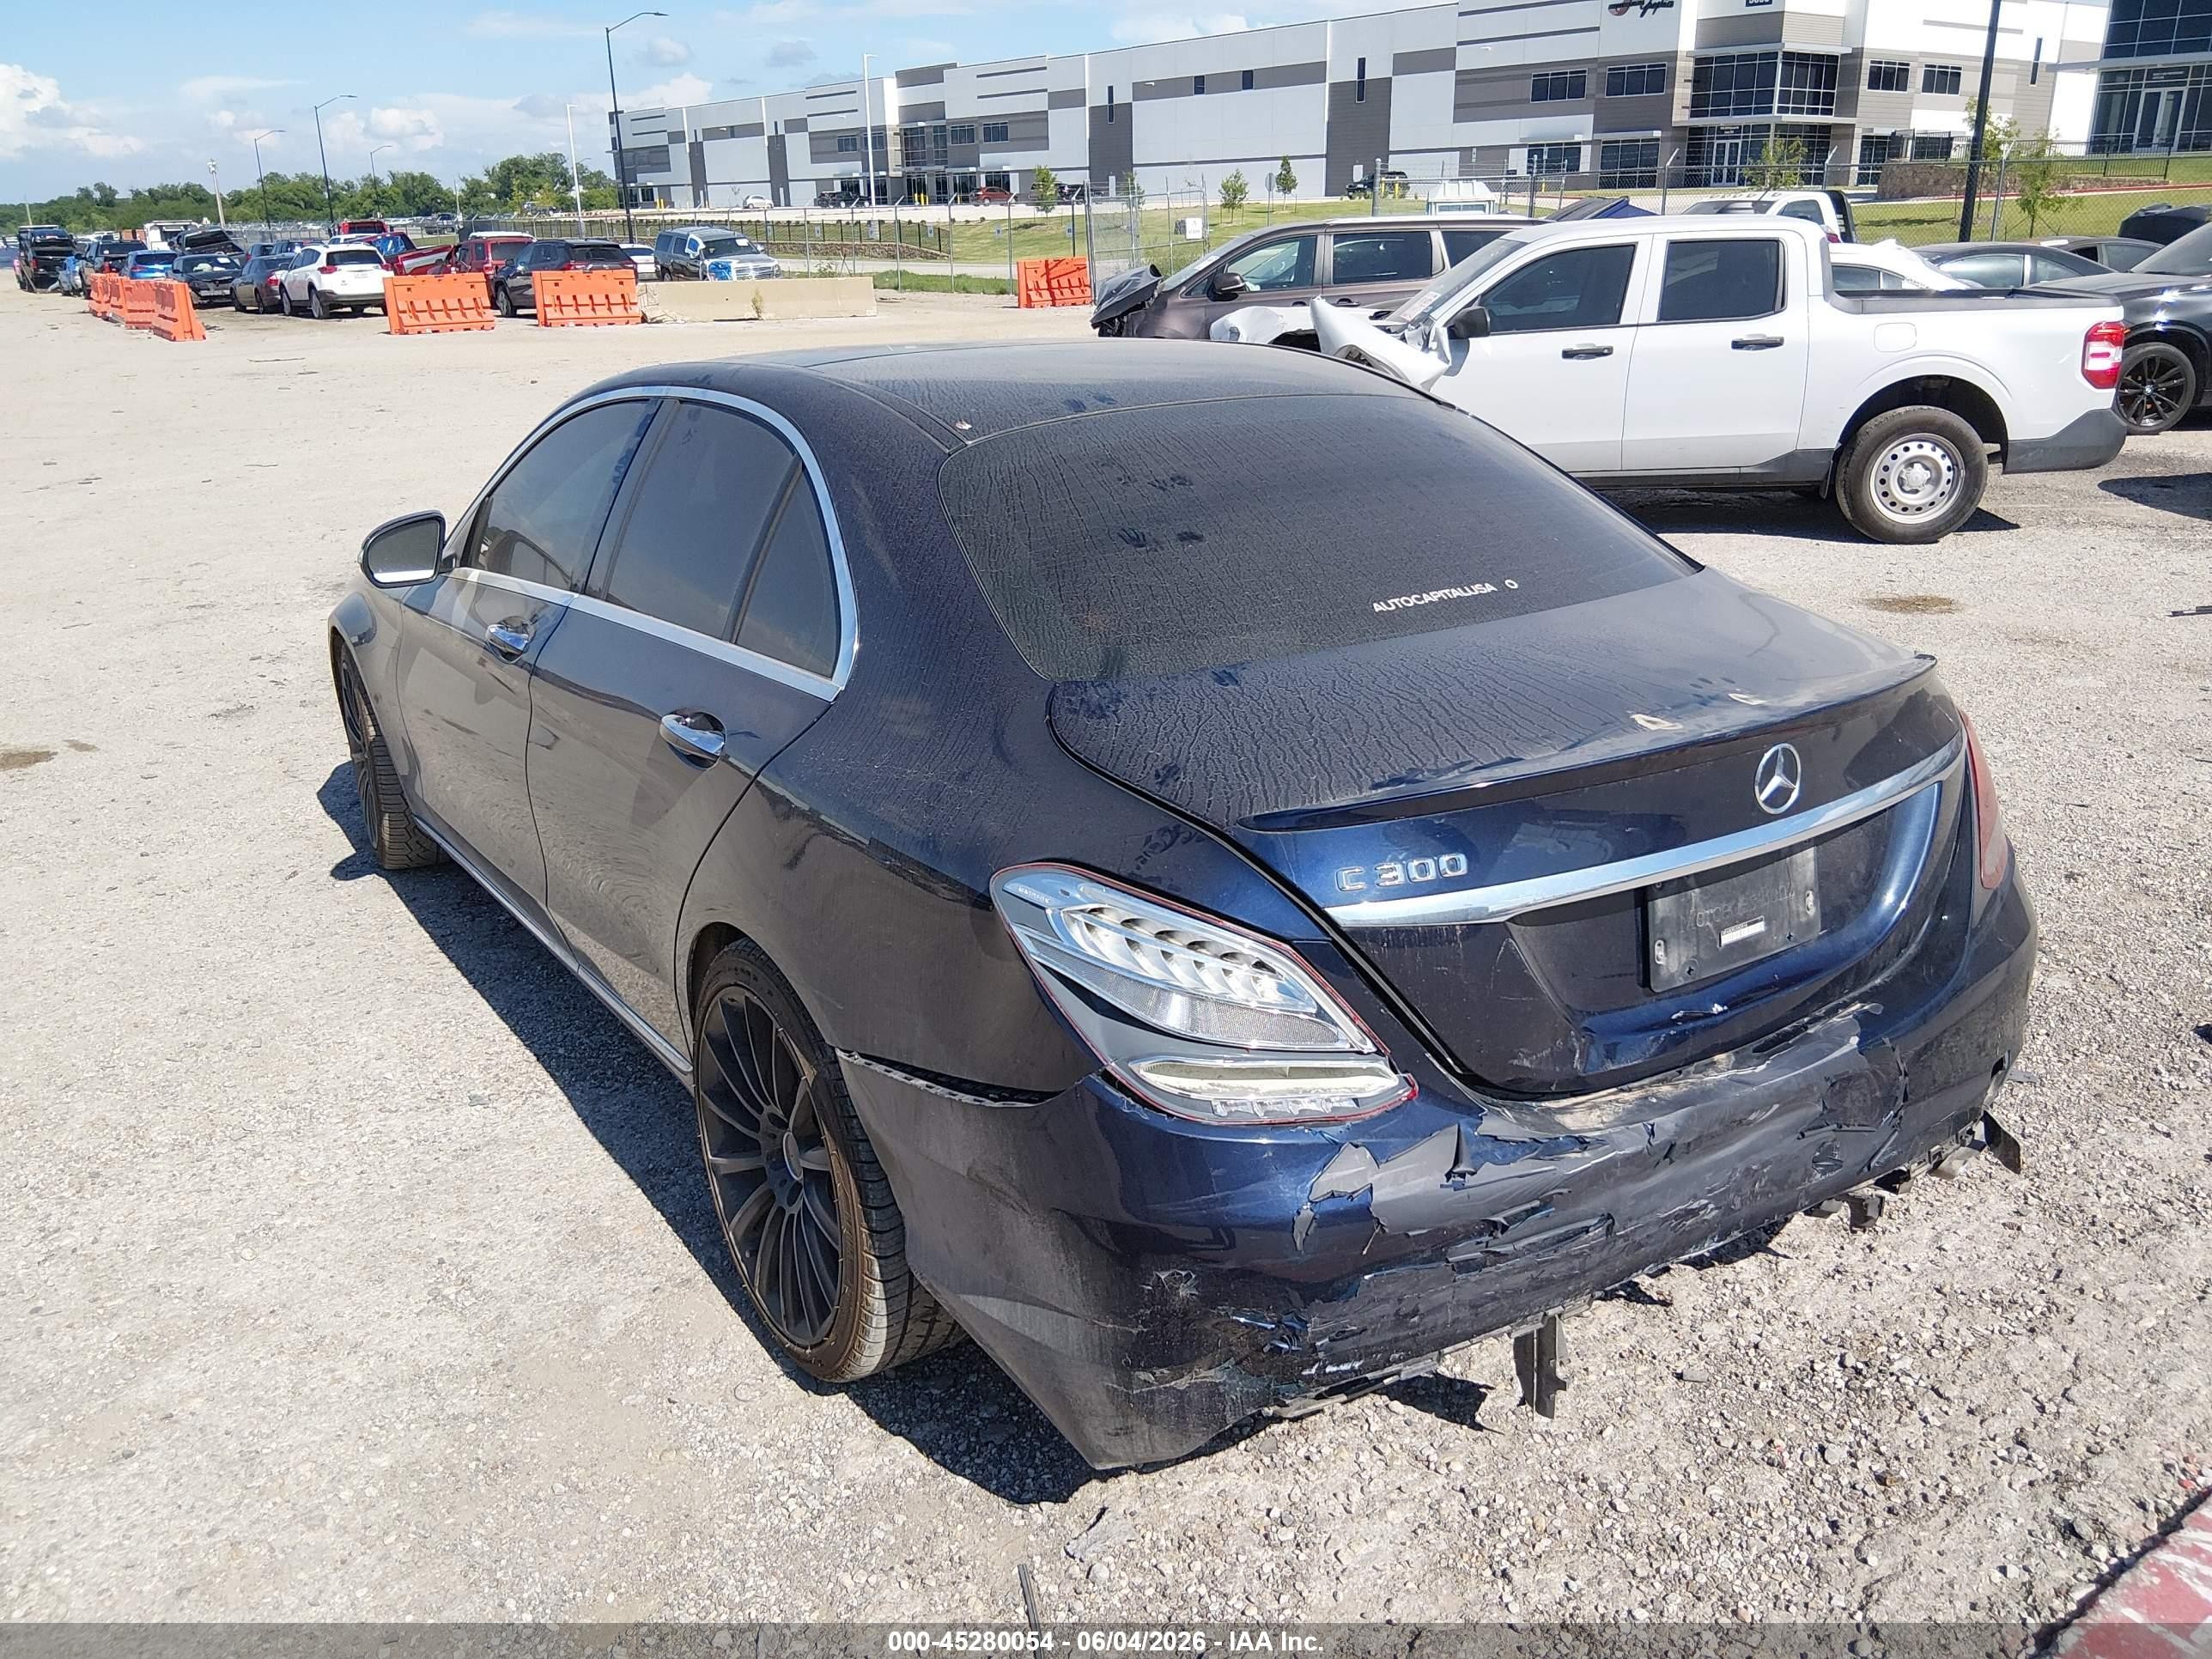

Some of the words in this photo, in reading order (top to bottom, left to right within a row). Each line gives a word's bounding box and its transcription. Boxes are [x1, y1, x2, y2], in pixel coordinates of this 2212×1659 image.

[1372, 581, 1498, 613] AUTOCAPITALUSA
[1334, 866, 1366, 892] C
[1374, 852, 1468, 888] 300
